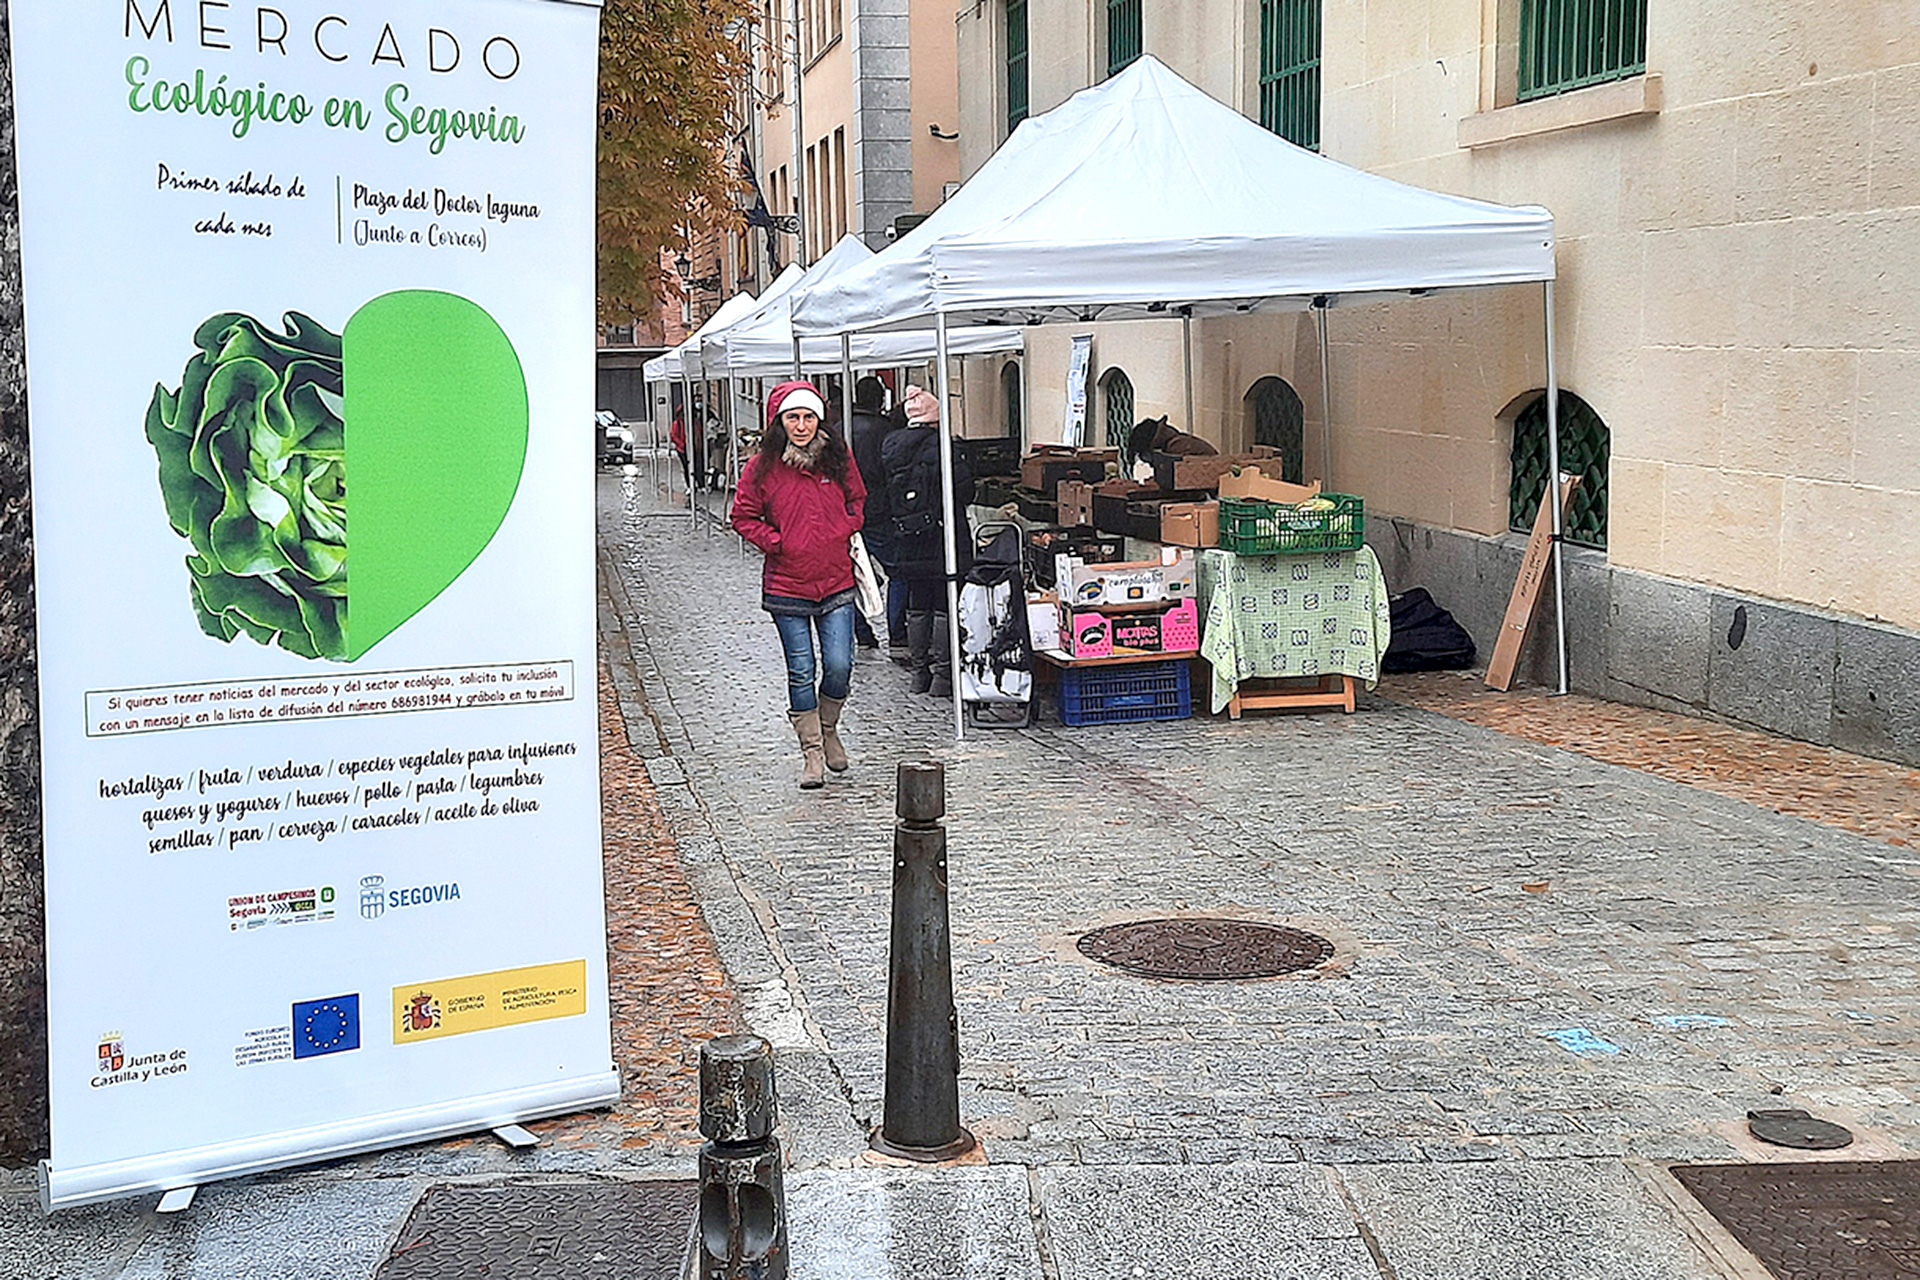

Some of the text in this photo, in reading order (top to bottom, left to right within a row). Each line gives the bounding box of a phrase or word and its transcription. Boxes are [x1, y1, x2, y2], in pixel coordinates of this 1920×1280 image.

[124, 0, 520, 80] MERCADO
[125, 56, 526, 155] Ecológico en Segovia
[158, 163, 306, 198] Primer sábado de
[353, 183, 541, 223] Plaza del Doctor Laguna
[195, 212, 272, 237] cada mes
[354, 219, 487, 252] (Junto a Correos)
[99, 685, 565, 732] con un mensaje en la lista de difusión del número 686981944 y grábalo en tu móvil
[108, 697, 121, 710] Si
[126, 695, 168, 711] quieres
[174, 692, 204, 704] tener
[209, 688, 253, 701] noticias
[258, 685, 276, 697] del
[281, 682, 328, 696] mercado
[333, 684, 340, 696] y
[344, 680, 361, 693] del
[365, 679, 399, 691] sector
[459, 672, 497, 685] solicita
[501, 672, 512, 683] tu
[516, 668, 558, 681] inclusión
[99, 775, 184, 799] hortalizas
[199, 768, 243, 794] fruta
[258, 760, 324, 782] verdura
[338, 756, 395, 781] especies
[399, 748, 464, 775] vegetales
[467, 749, 505, 770] para
[508, 742, 577, 766] infusiones
[142, 805, 195, 831] quesos
[199, 803, 212, 824] y
[215, 796, 281, 823] yogures
[296, 789, 350, 808] huevos
[364, 781, 403, 808] pollo
[416, 777, 457, 802] pasta
[470, 768, 545, 796] legumbres
[149, 829, 214, 854] semillas
[229, 828, 264, 851] pan
[278, 820, 337, 842] cerveza
[352, 808, 421, 831] caracoles
[434, 802, 477, 822] aceite
[480, 798, 499, 816] de
[502, 796, 540, 815] oliva
[229, 905, 267, 919] Segovia
[389, 882, 461, 908] SEGOVIA
[91, 1062, 187, 1087] Castilla y León
[127, 1049, 187, 1068] Junta de
